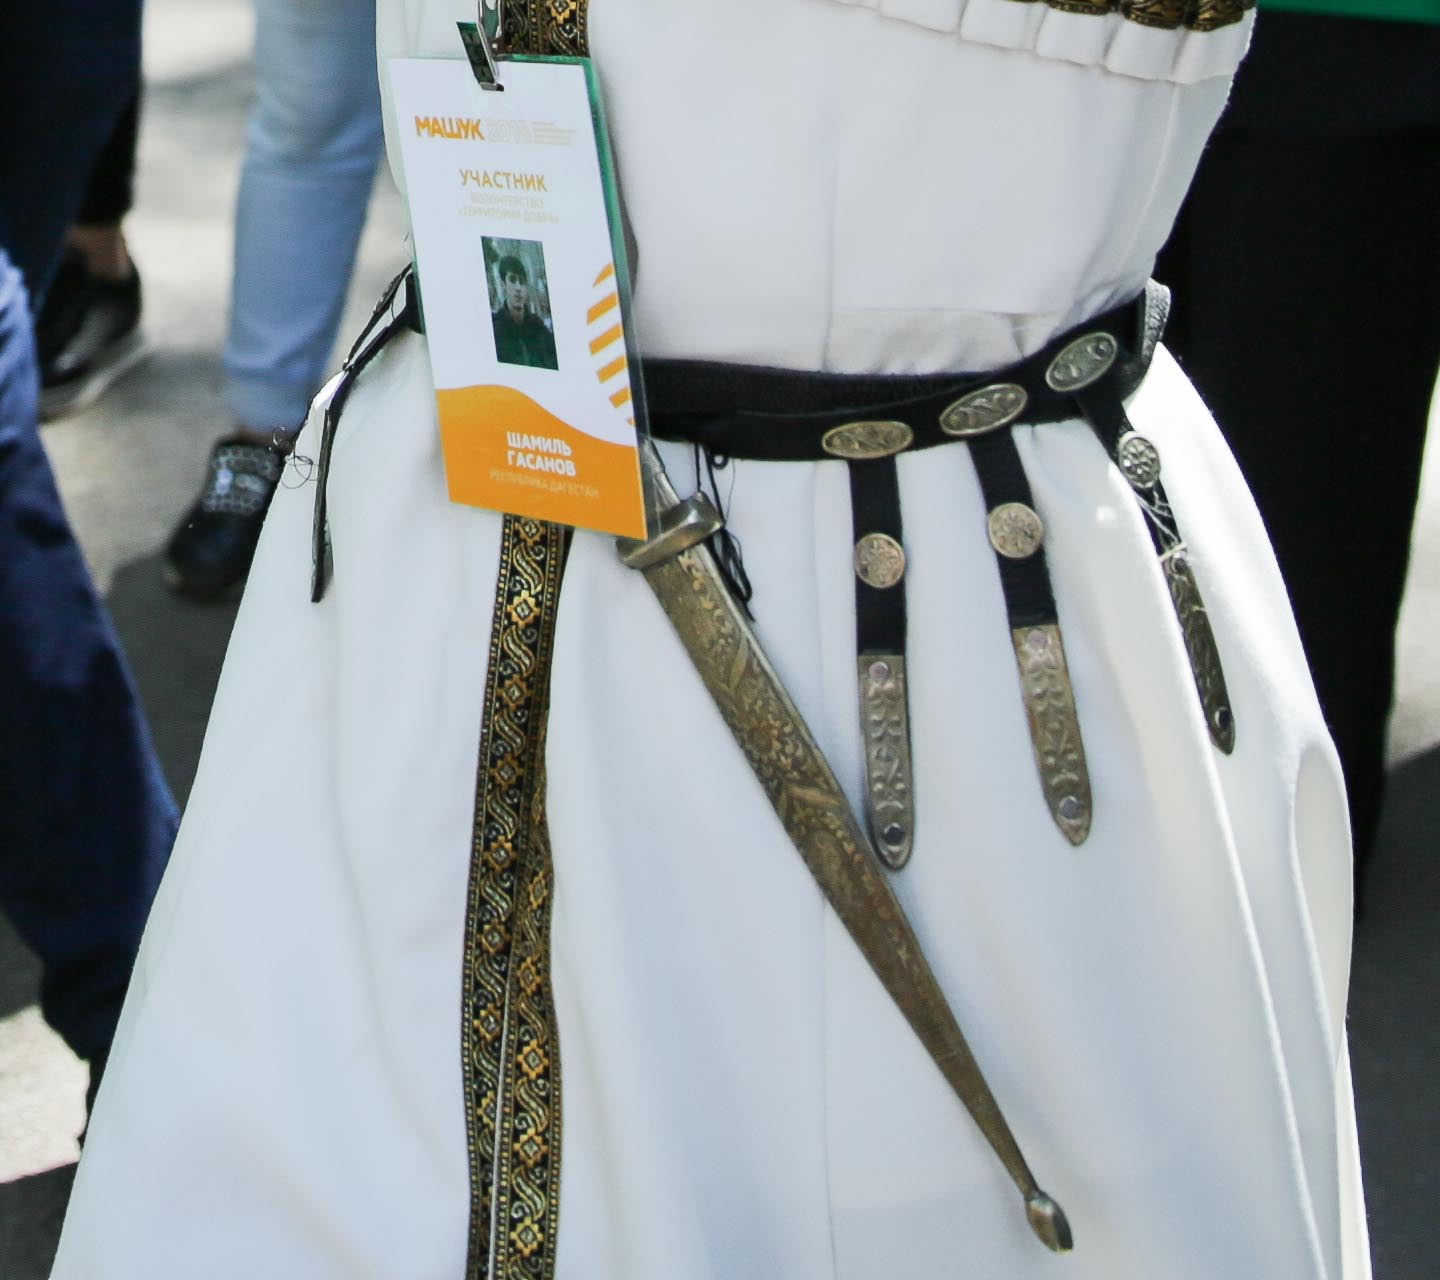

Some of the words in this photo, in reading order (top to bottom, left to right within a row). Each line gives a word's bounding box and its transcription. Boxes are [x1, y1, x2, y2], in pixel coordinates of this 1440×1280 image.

[414, 115, 486, 141] МАШУК
[458, 168, 549, 193] УЧАСТНИК
[506, 431, 573, 457] ШАМИЛЬ
[507, 450, 577, 477] ГАСАНОВ
